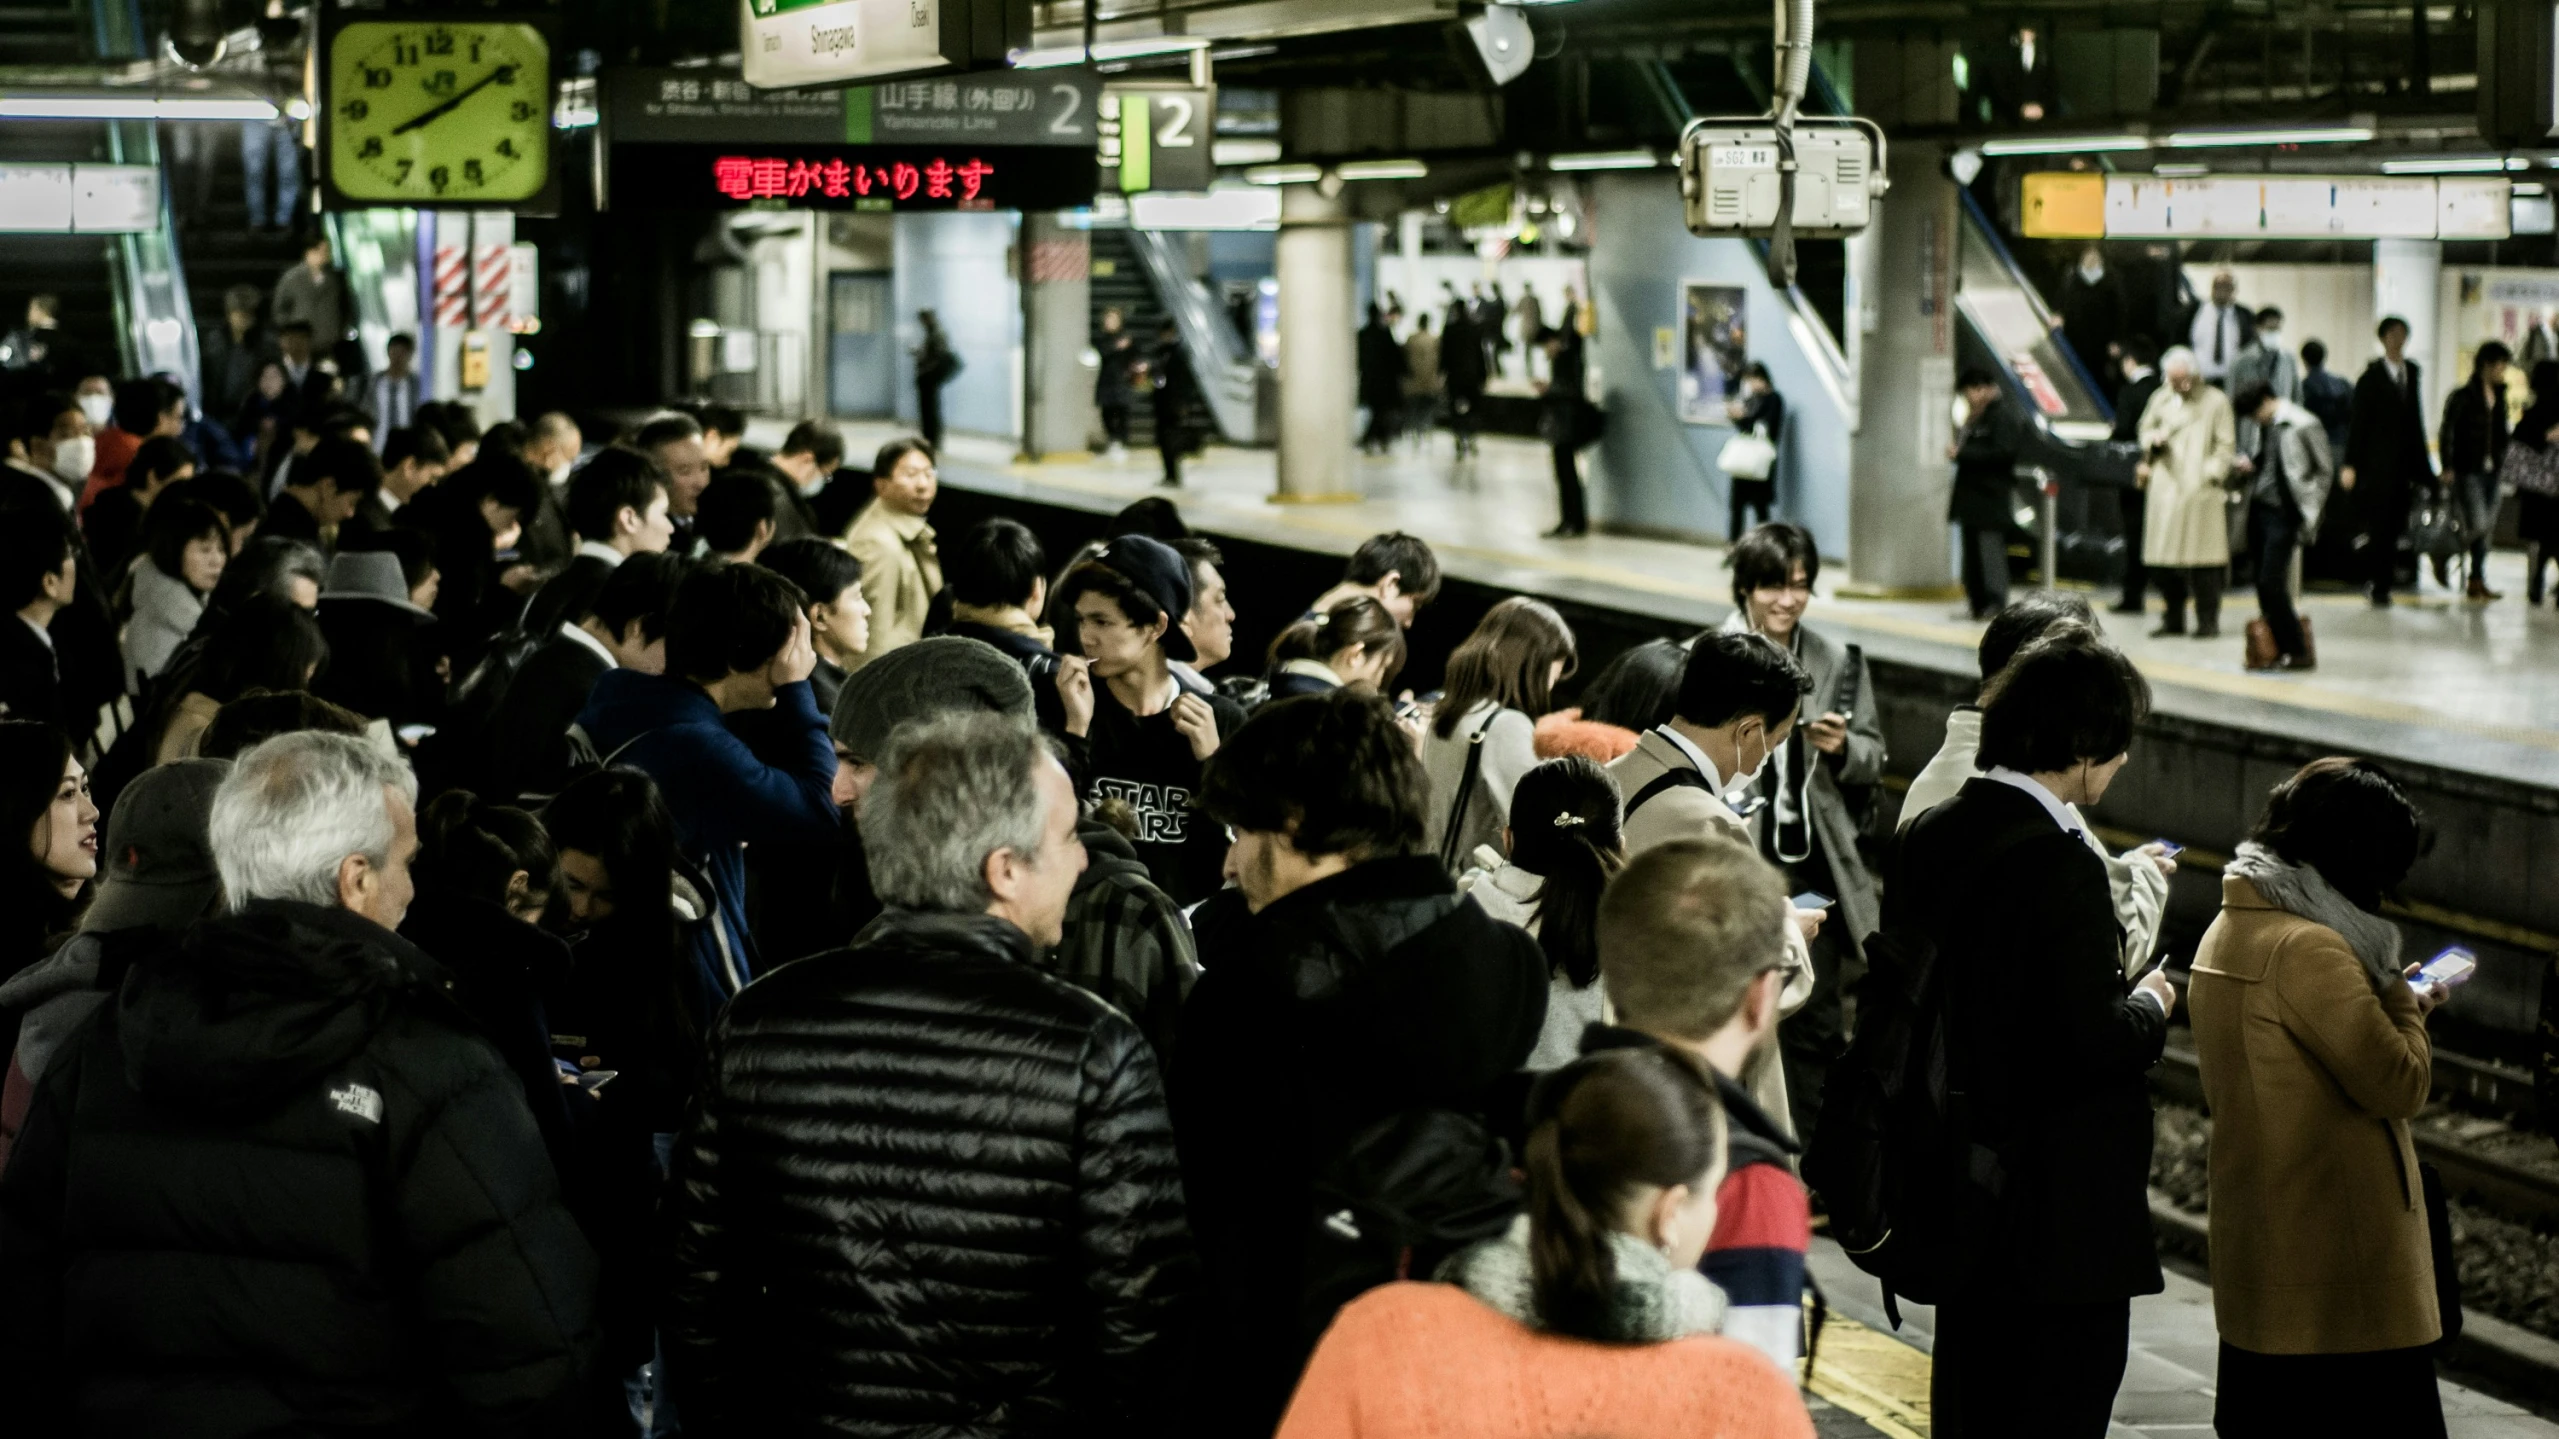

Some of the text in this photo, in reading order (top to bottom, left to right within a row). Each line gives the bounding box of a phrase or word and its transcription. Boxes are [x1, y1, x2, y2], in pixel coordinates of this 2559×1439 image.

[425, 34, 454, 56] 12
[811, 24, 856, 57] Shinagawa
[365, 67, 393, 89] 10
[421, 70, 457, 97] JR
[349, 99, 369, 122] 9
[510, 100, 530, 123] 3
[1050, 84, 1083, 134] 2
[963, 115, 998, 130] Line
[1157, 96, 1195, 148] 2
[364, 136, 383, 158] 8
[495, 137, 513, 158] 4
[396, 158, 414, 183] 7
[429, 165, 449, 188] 6
[463, 159, 482, 182] 5
[713, 156, 995, 200] 電車がまいります
